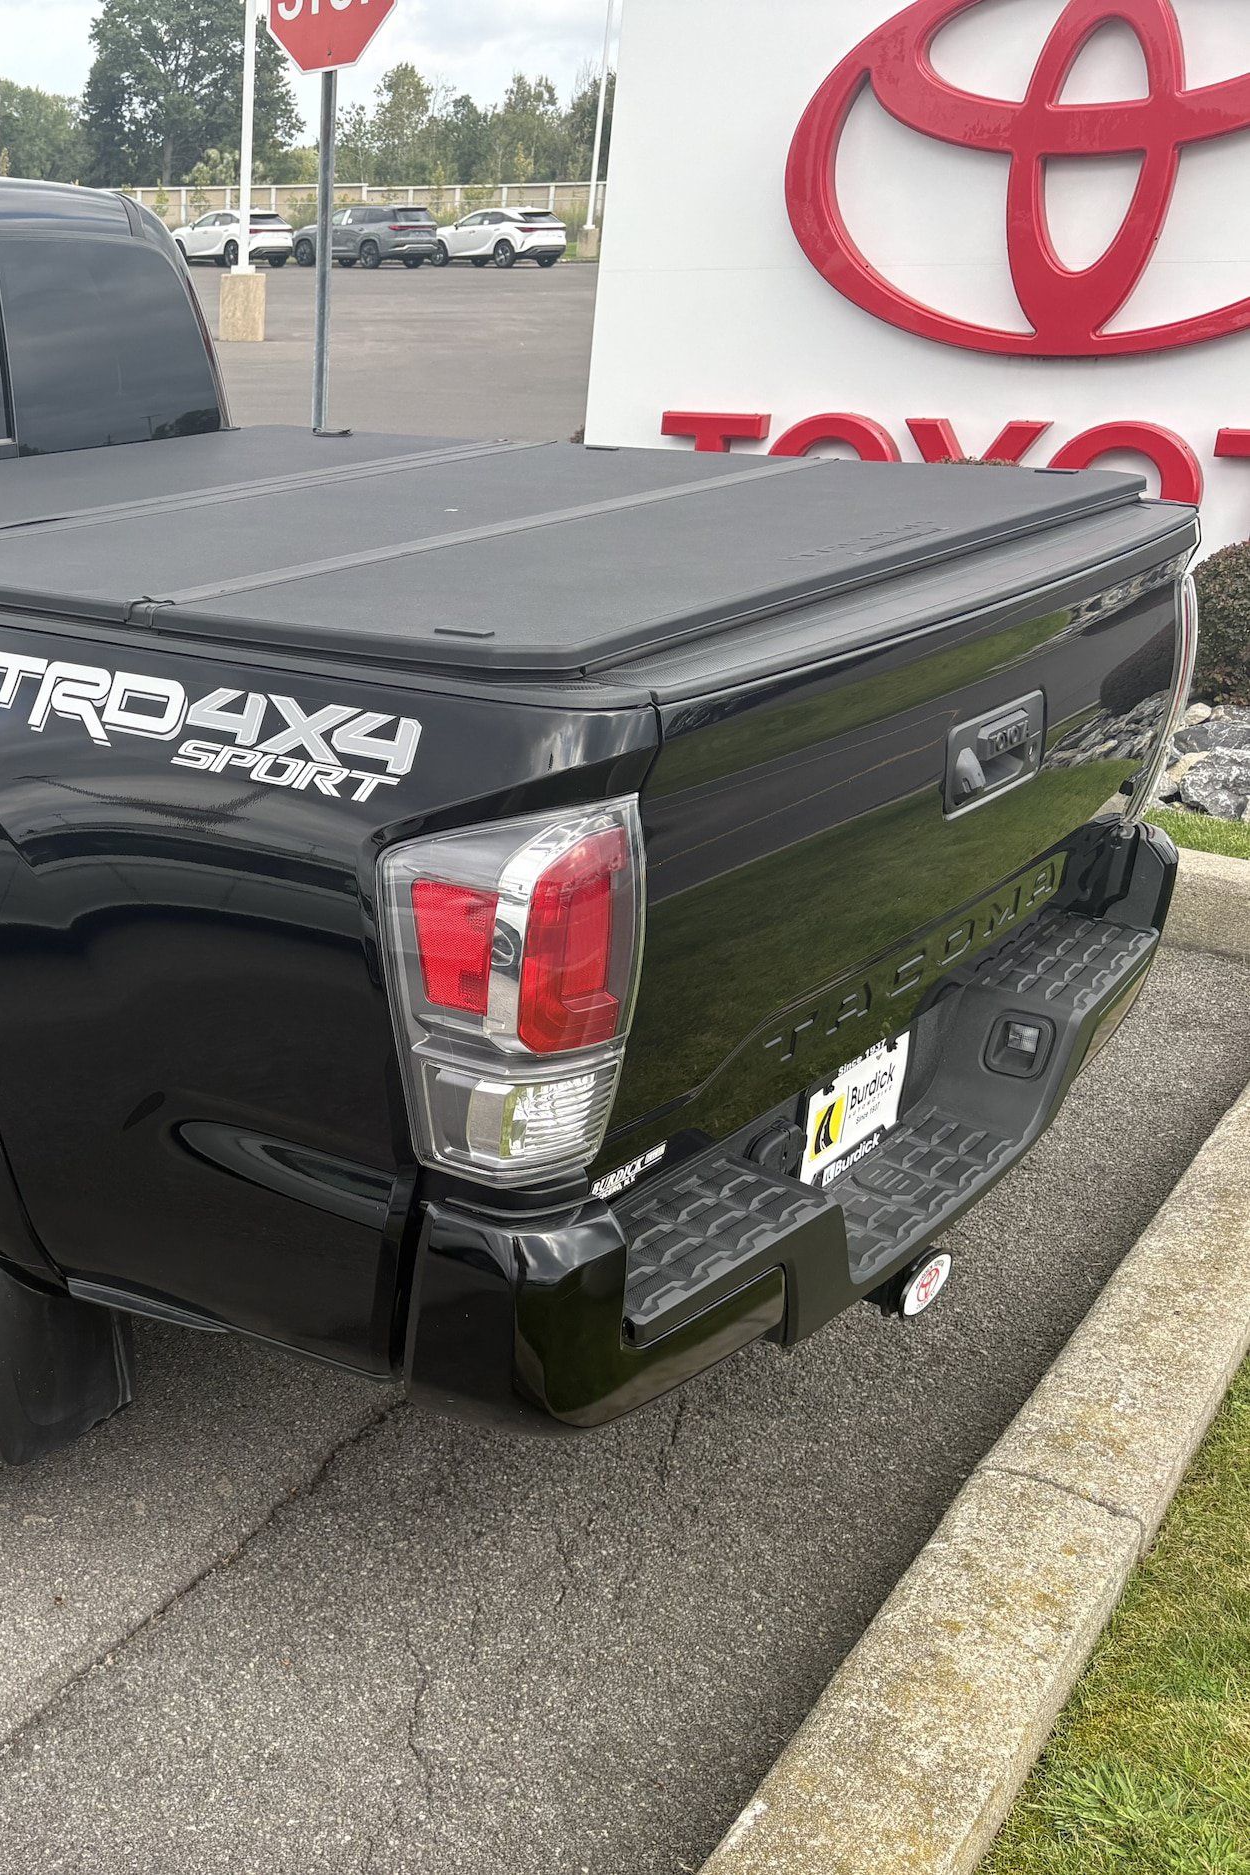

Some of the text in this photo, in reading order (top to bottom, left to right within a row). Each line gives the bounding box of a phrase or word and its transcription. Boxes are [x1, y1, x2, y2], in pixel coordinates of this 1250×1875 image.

[171, 739, 401, 803] SPORT
[764, 861, 1055, 1062] TACOMA
[838, 1055, 864, 1077] Since
[850, 1062, 896, 1111] Burdick
[591, 1156, 645, 1195] BURDICK
[834, 1132, 881, 1178] Burdick
